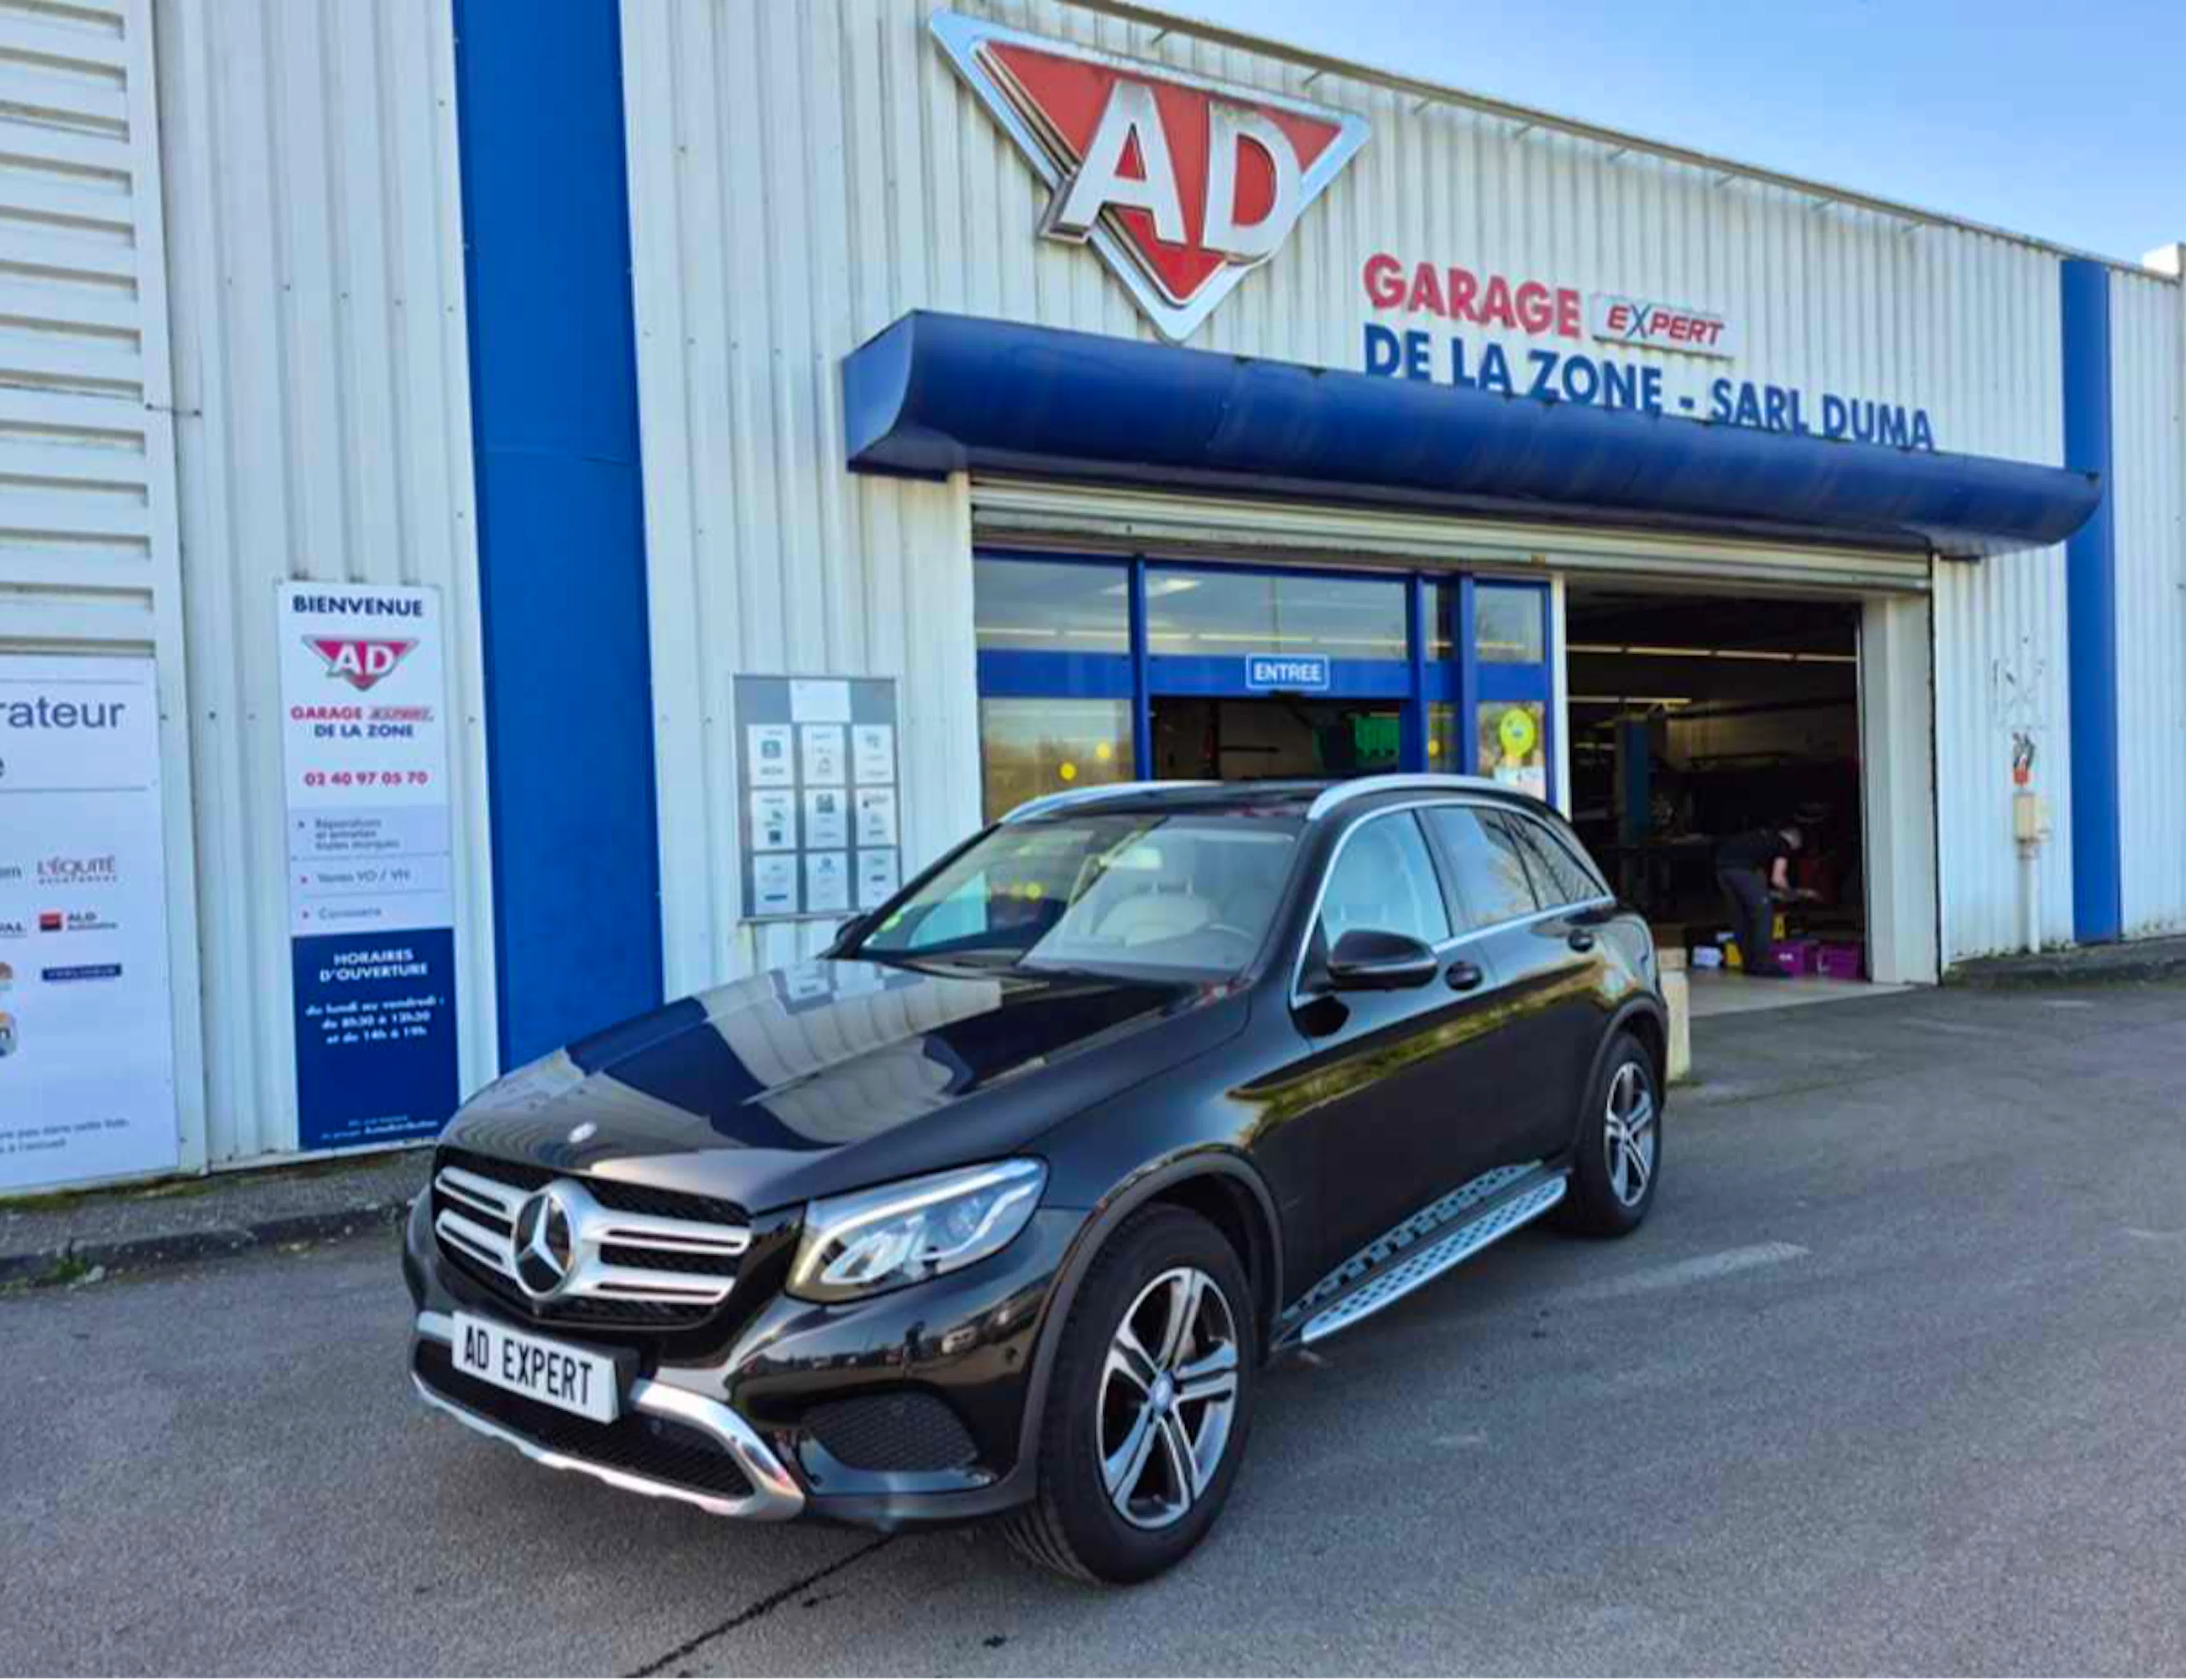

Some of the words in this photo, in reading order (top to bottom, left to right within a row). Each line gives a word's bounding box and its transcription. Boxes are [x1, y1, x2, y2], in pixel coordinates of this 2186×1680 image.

[1053, 79, 1304, 260] AD
[1363, 253, 1581, 339] GARAGE
[1607, 304, 1725, 344] EXPERT
[1365, 322, 1432, 381] DE
[1451, 337, 1514, 400] LA
[1528, 348, 1663, 415] ZONE
[1710, 377, 1808, 435] SARL
[1822, 393, 1934, 452] DUMA
[293, 595, 422, 616] BIENVENUE
[336, 642, 394, 674] AD
[1254, 662, 1322, 682] ENTREE
[0, 697, 125, 728] ateur
[290, 706, 362, 720] GARAGE
[314, 724, 335, 737] DE
[342, 724, 361, 737] LA
[368, 724, 413, 737] ZONE
[334, 949, 414, 965] HORAIRES
[320, 962, 427, 982] D'OUVERTURE
[464, 1325, 489, 1369] AD
[503, 1337, 593, 1405] EXPERT
